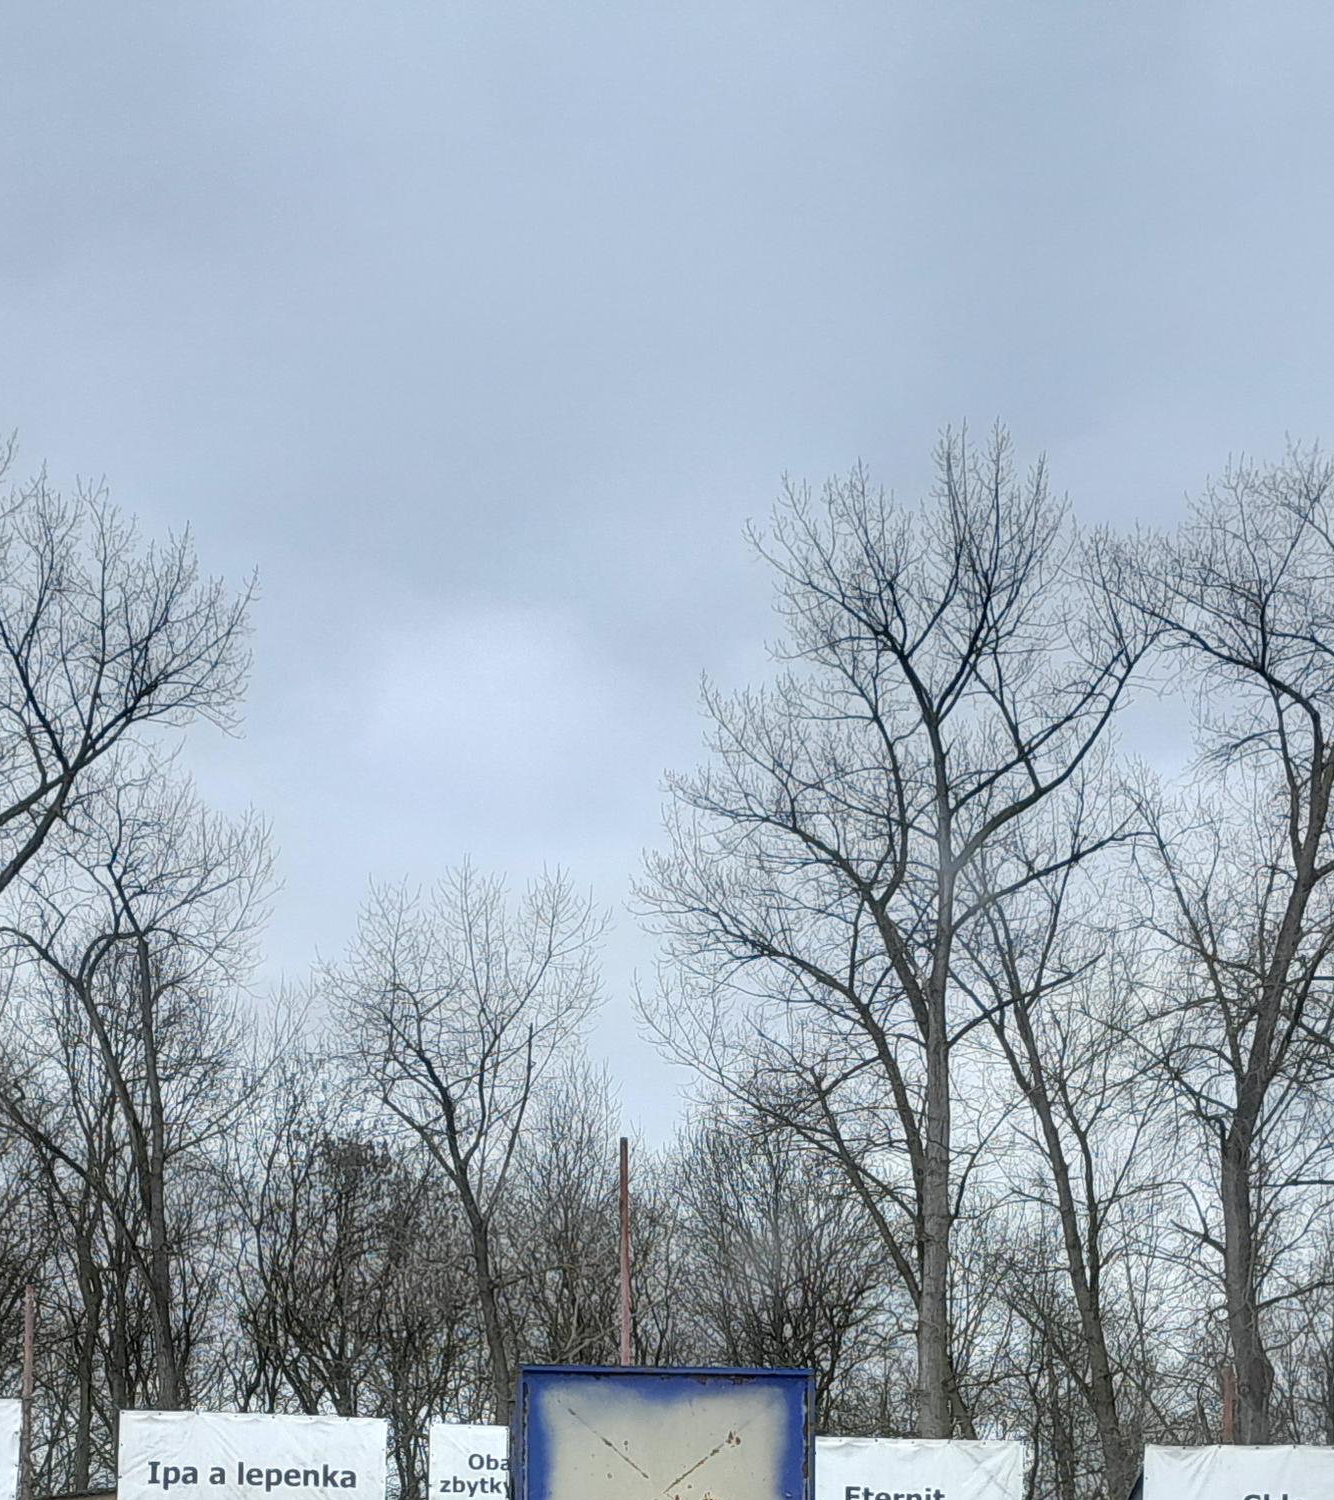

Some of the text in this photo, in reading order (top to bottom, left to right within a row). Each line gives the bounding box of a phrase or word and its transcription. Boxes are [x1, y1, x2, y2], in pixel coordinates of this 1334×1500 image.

[147, 1461, 357, 1492] Ipa a lepenka
